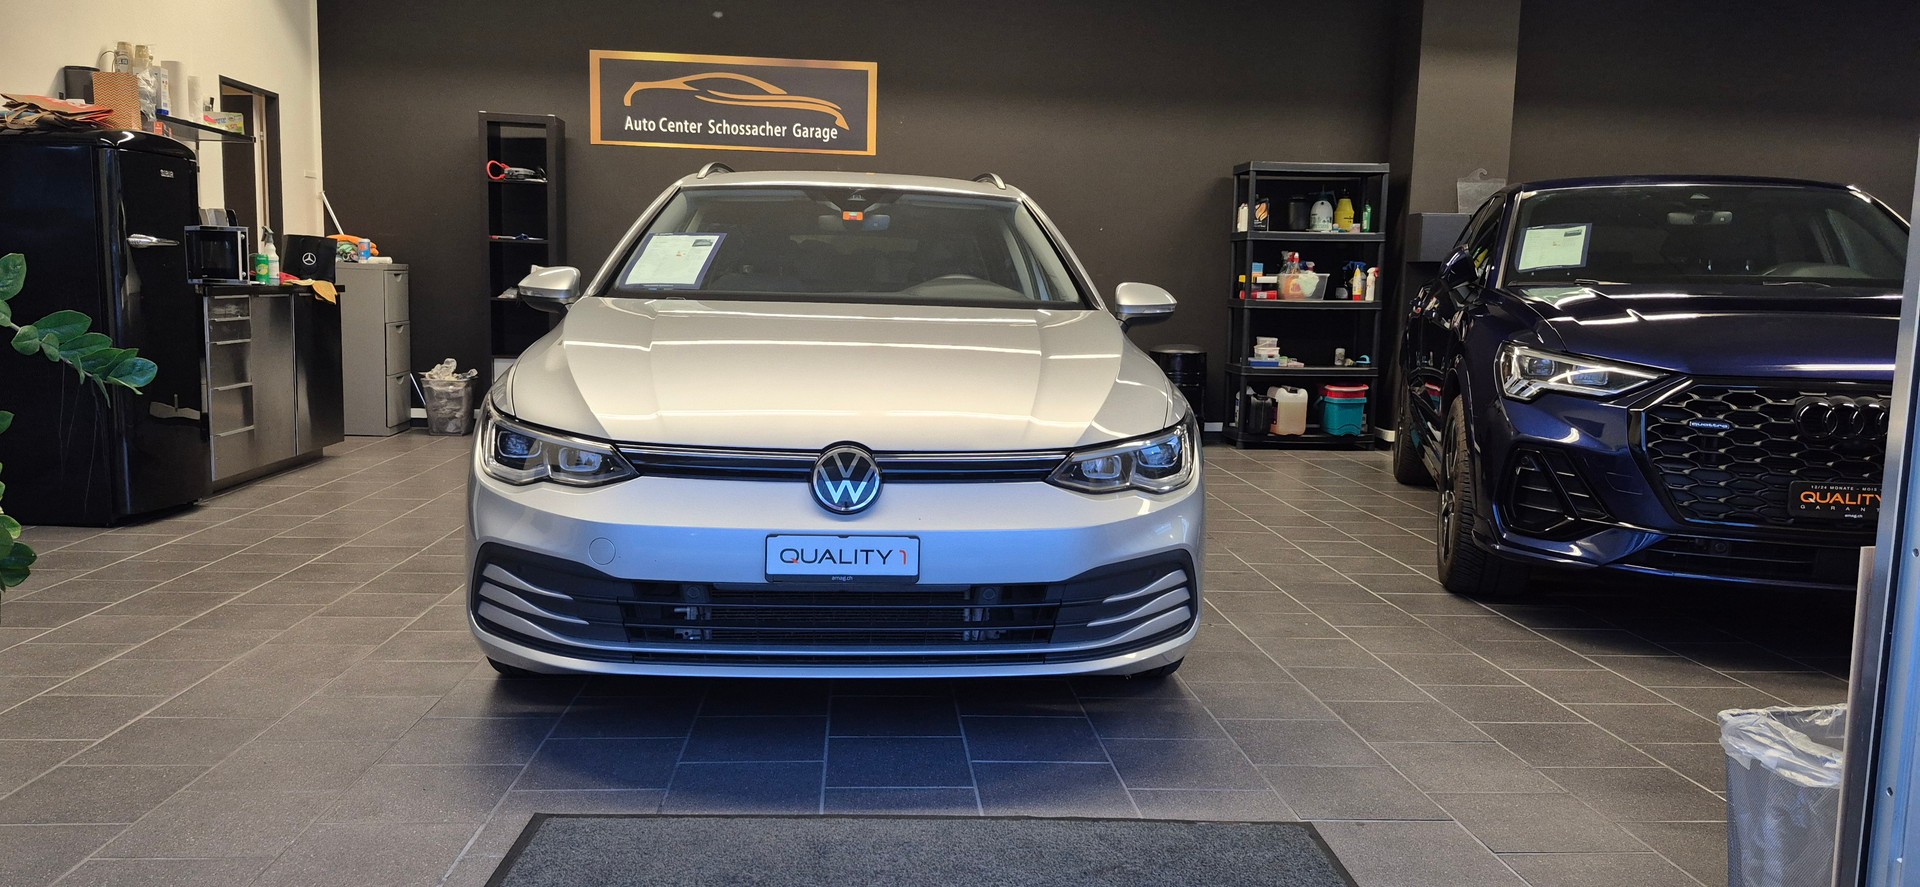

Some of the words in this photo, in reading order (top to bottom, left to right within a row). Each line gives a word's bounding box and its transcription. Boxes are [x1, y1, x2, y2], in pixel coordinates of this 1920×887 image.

[624, 115, 656, 132] Auto
[658, 117, 703, 134] Center
[707, 119, 788, 137] Schossacher
[792, 123, 838, 143] Garage
[779, 548, 893, 565] QUALITY
